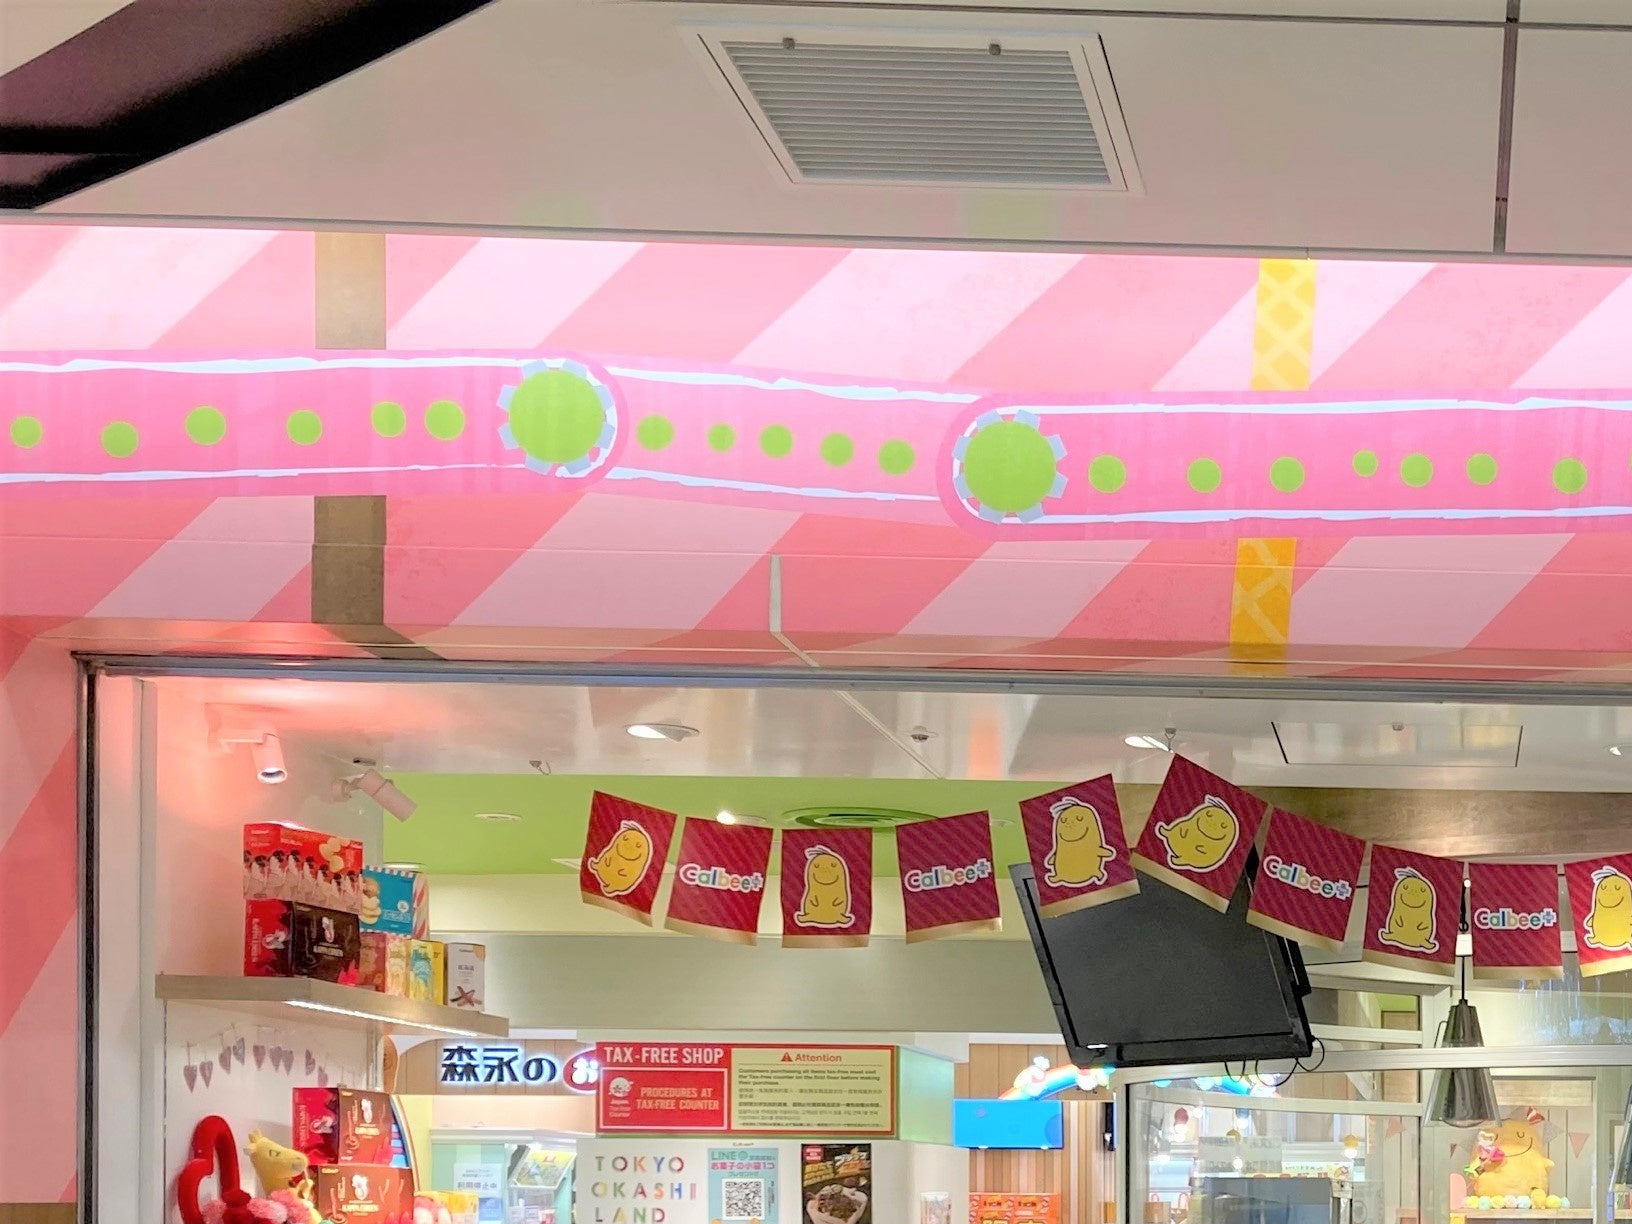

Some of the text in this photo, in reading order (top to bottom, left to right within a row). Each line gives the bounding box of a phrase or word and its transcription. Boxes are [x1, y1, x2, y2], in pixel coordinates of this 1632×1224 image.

[603, 1047, 724, 1064] TAX-FREE SHOP
[795, 1053, 842, 1063] Attention
[640, 1086, 714, 1098] PROCEDURES AT
[678, 1099, 720, 1110] COUNTER
[595, 1155, 685, 1173] TOKYO
[591, 1181, 697, 1200] OKASHI
[594, 1207, 666, 1224] LAND
